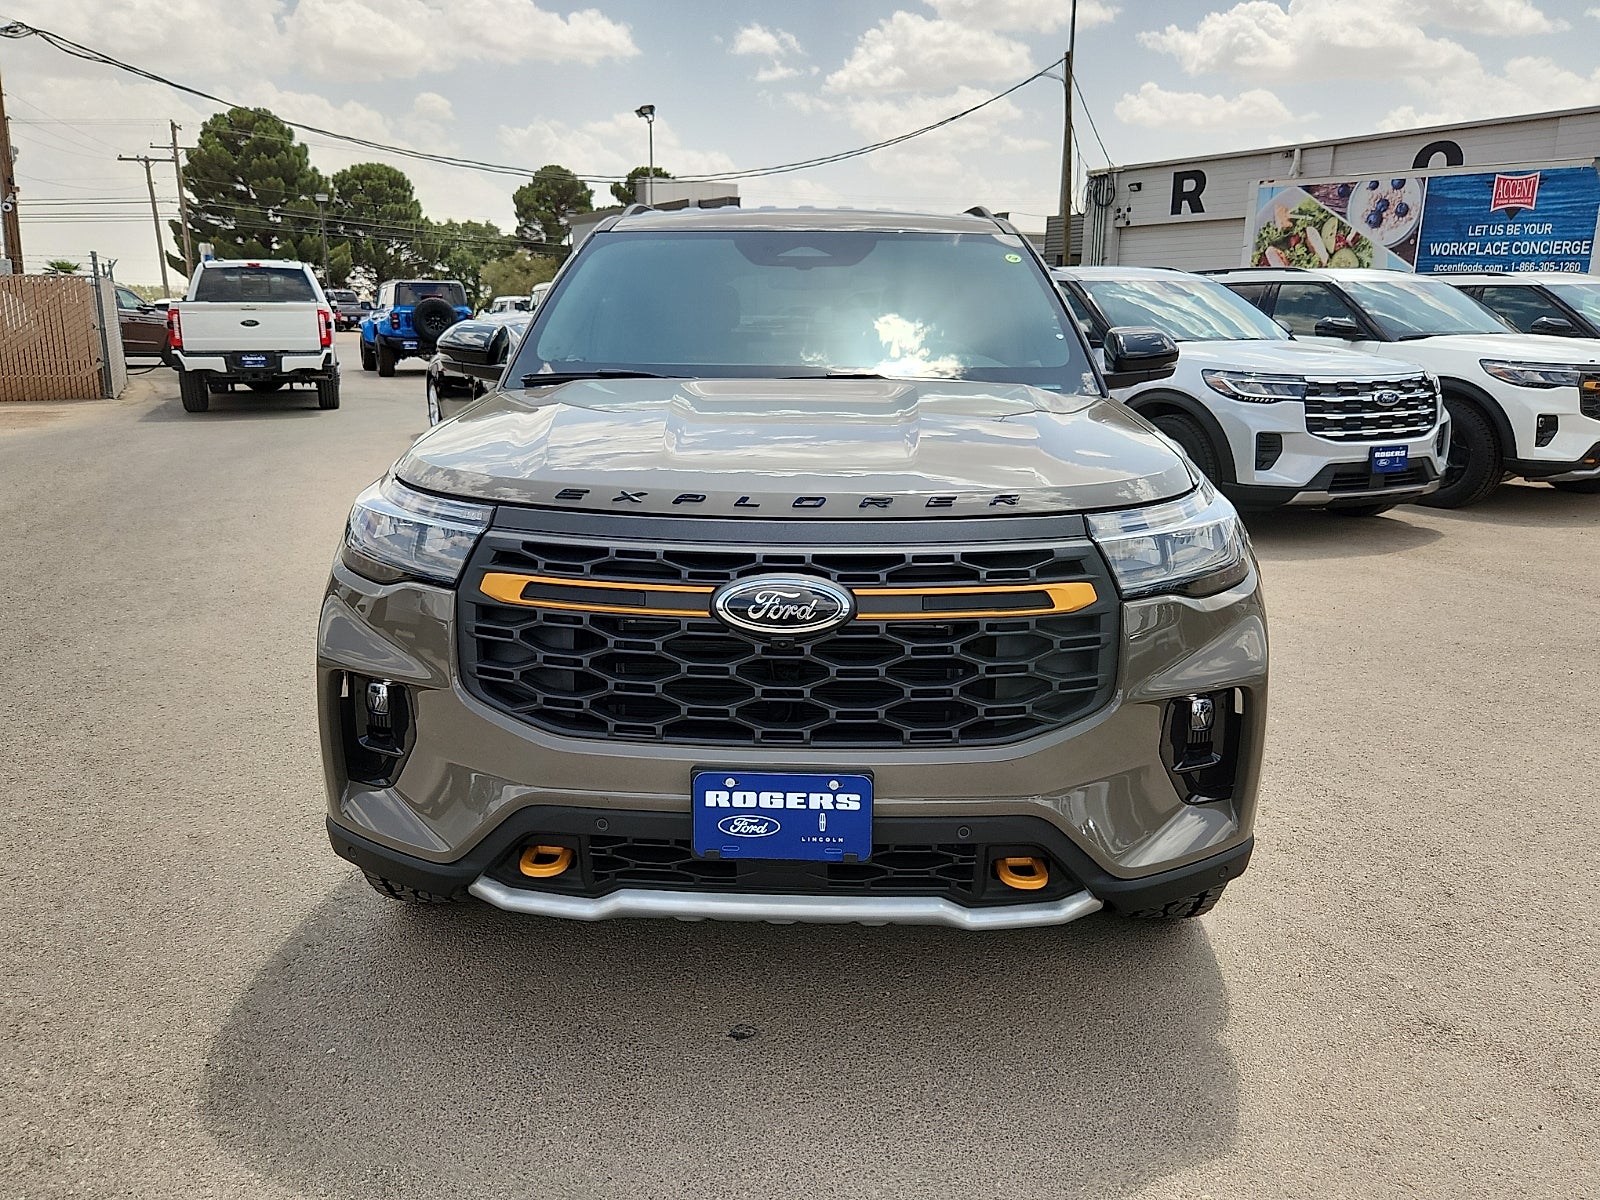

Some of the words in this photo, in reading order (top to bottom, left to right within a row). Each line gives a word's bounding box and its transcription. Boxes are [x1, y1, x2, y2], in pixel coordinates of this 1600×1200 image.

[1170, 169, 1207, 216] R
[1495, 176, 1537, 199] ACCENT
[1468, 224, 1488, 237] LET
[1489, 224, 1504, 236] US
[1506, 223, 1521, 236] BE
[1523, 223, 1553, 235] YOUR
[1430, 242, 1510, 256] WORKPLACE
[1512, 240, 1592, 255] CONCIERGE
[1433, 262, 1503, 272] accentfoods.com
[1511, 261, 1581, 273] 1-866-305-1260
[554, 487, 1021, 509] EXPLORER
[747, 590, 820, 621] Ford
[704, 790, 861, 811] ROGERS
[729, 817, 770, 834] Ford
